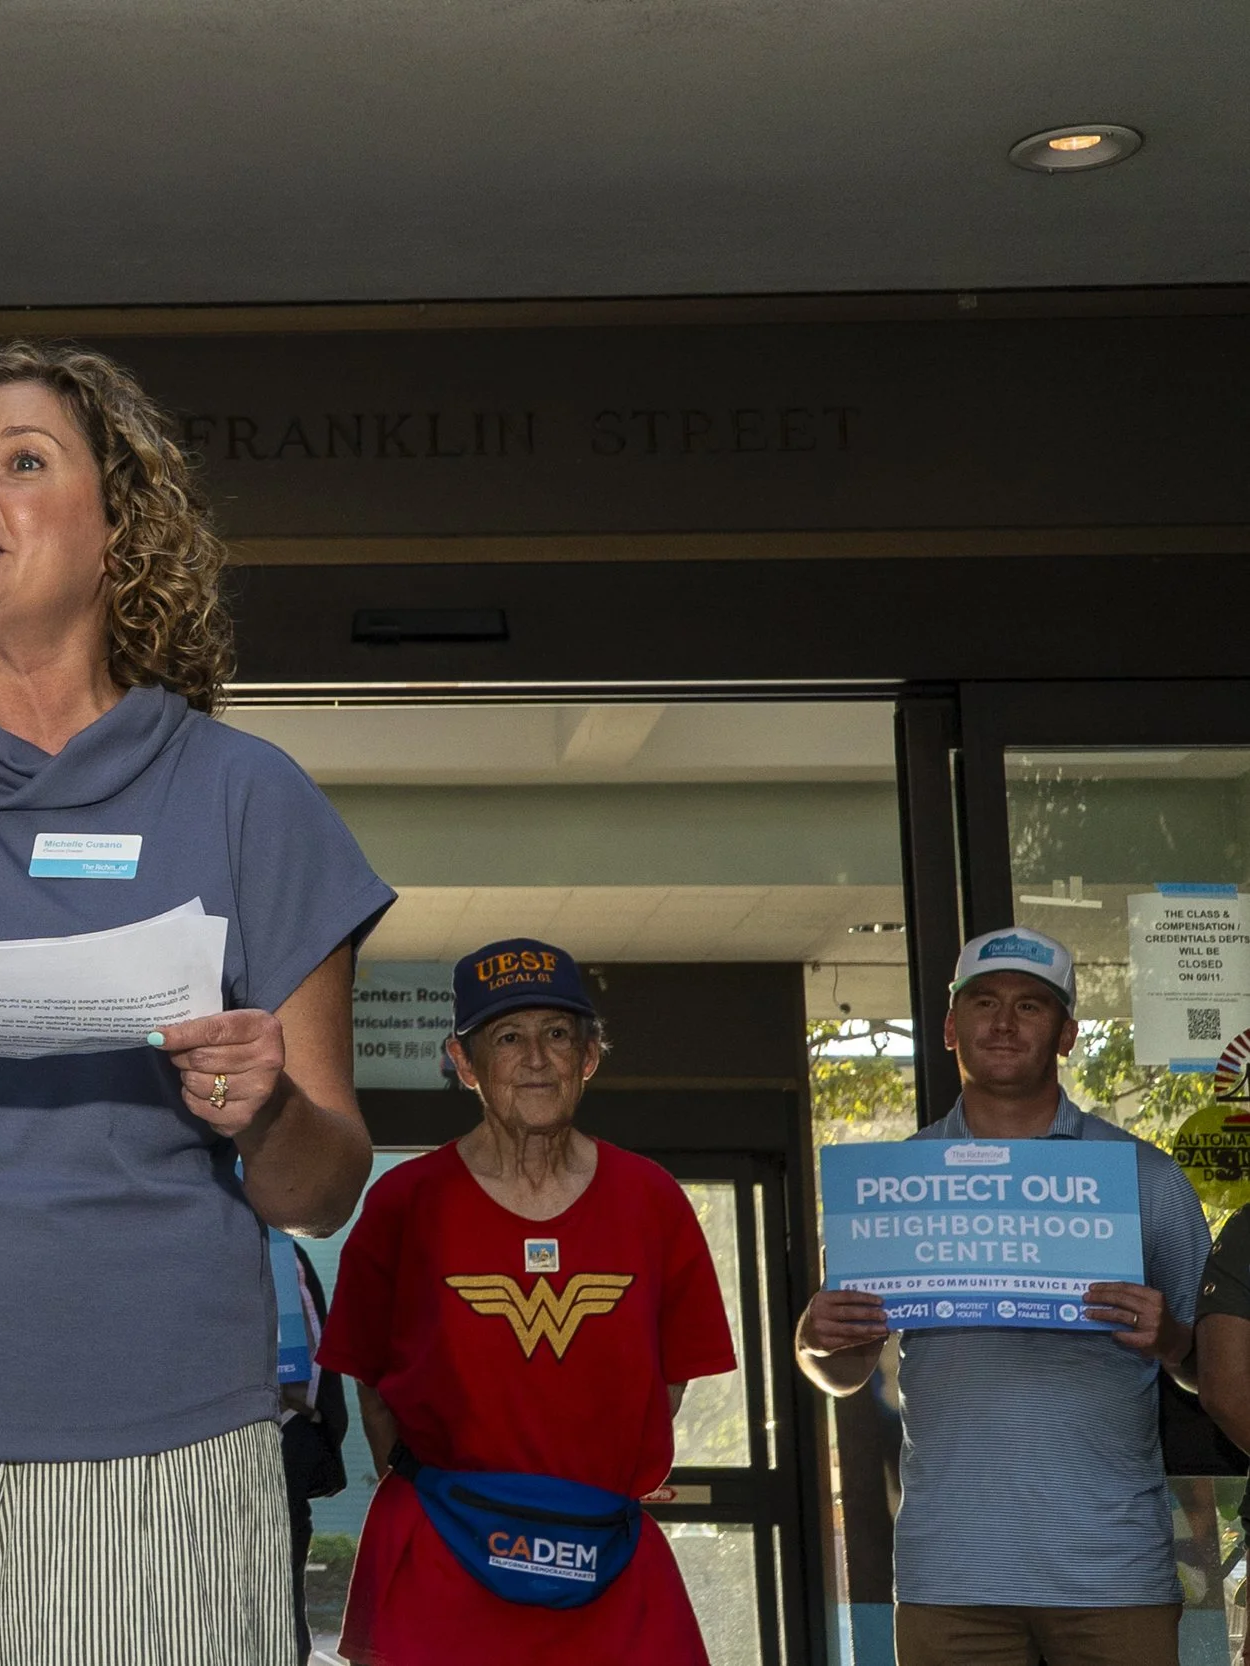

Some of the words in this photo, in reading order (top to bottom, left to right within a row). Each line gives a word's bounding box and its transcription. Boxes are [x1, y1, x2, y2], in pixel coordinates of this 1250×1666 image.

[181, 410, 536, 460] FRANKLIN
[591, 406, 865, 457] STREET
[1165, 910, 1184, 918] THE
[1186, 910, 1220, 918] CLASS
[1223, 910, 1230, 918] &
[1155, 922, 1235, 931] COMPENSATION
[1145, 934, 1216, 943] CREDENTIALS
[1179, 947, 1203, 956] WILL
[1206, 947, 1220, 956] BE
[474, 951, 558, 981] UESF
[1178, 960, 1223, 969] CLOSED
[488, 973, 534, 991] LOCAL
[1179, 973, 1194, 981] ON
[145, 998, 178, 1008] community
[1177, 1133, 1250, 1146] AUTOMA
[857, 1174, 1013, 1204] PROTECT
[1021, 1175, 1100, 1204] OUR
[852, 1214, 1114, 1240] NEIGHBORHOOD
[915, 1241, 1041, 1263] CENTER
[864, 1280, 903, 1291] YEARS
[907, 1279, 922, 1288] OF
[927, 1278, 1007, 1288] COMMUNITY
[1013, 1279, 1068, 1290] SERVICE
[1072, 1282, 1088, 1291] AT
[956, 1302, 988, 1310] PROTECT
[1017, 1302, 1051, 1311] PROTECT
[956, 1311, 982, 1319] YOUTH
[1017, 1311, 1051, 1320] FAMILIES
[488, 1531, 597, 1570] CADEM
[491, 1558, 530, 1570] CALIFORNIA
[530, 1564, 573, 1577] DEMOCRATIC
[574, 1571, 594, 1580] PARTY
